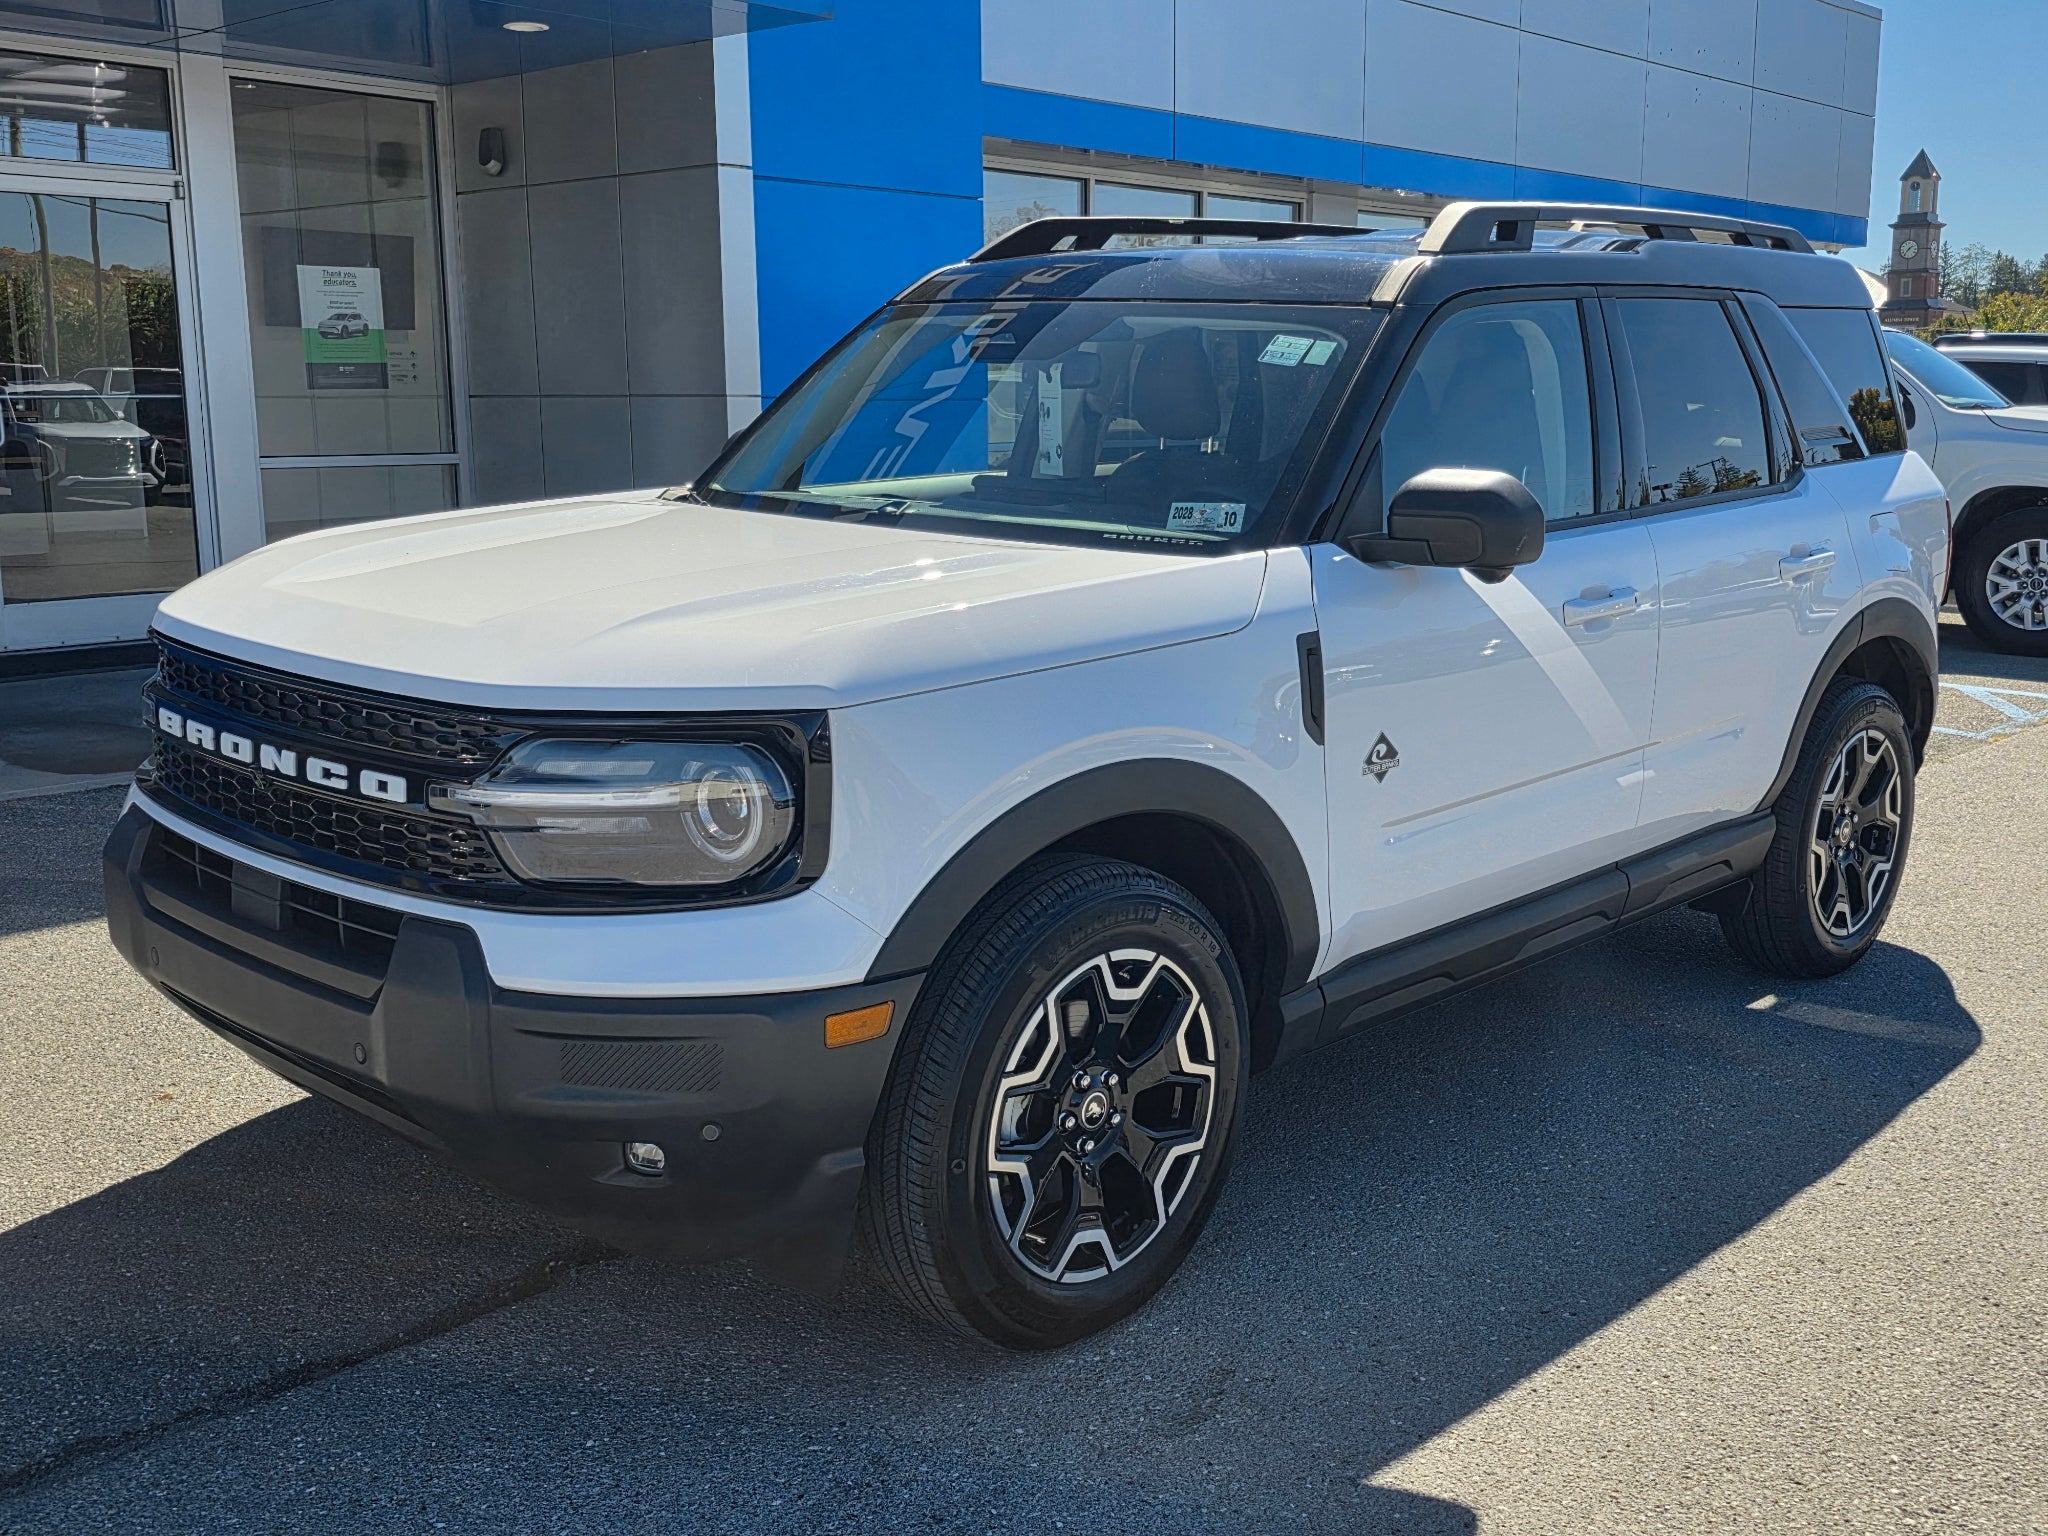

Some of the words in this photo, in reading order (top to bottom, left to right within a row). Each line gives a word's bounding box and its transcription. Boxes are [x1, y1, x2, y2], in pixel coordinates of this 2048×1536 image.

[322, 269, 342, 277] Thank
[323, 278, 357, 287] educators.
[1172, 506, 1194, 520] 2028
[1223, 511, 1238, 527] 10
[158, 706, 408, 804] BRONCO
[1363, 763, 1381, 775] OUTER
[1381, 758, 1399, 770] BANKS
[1200, 931, 1208, 943] R
[1207, 940, 1217, 953] 18
